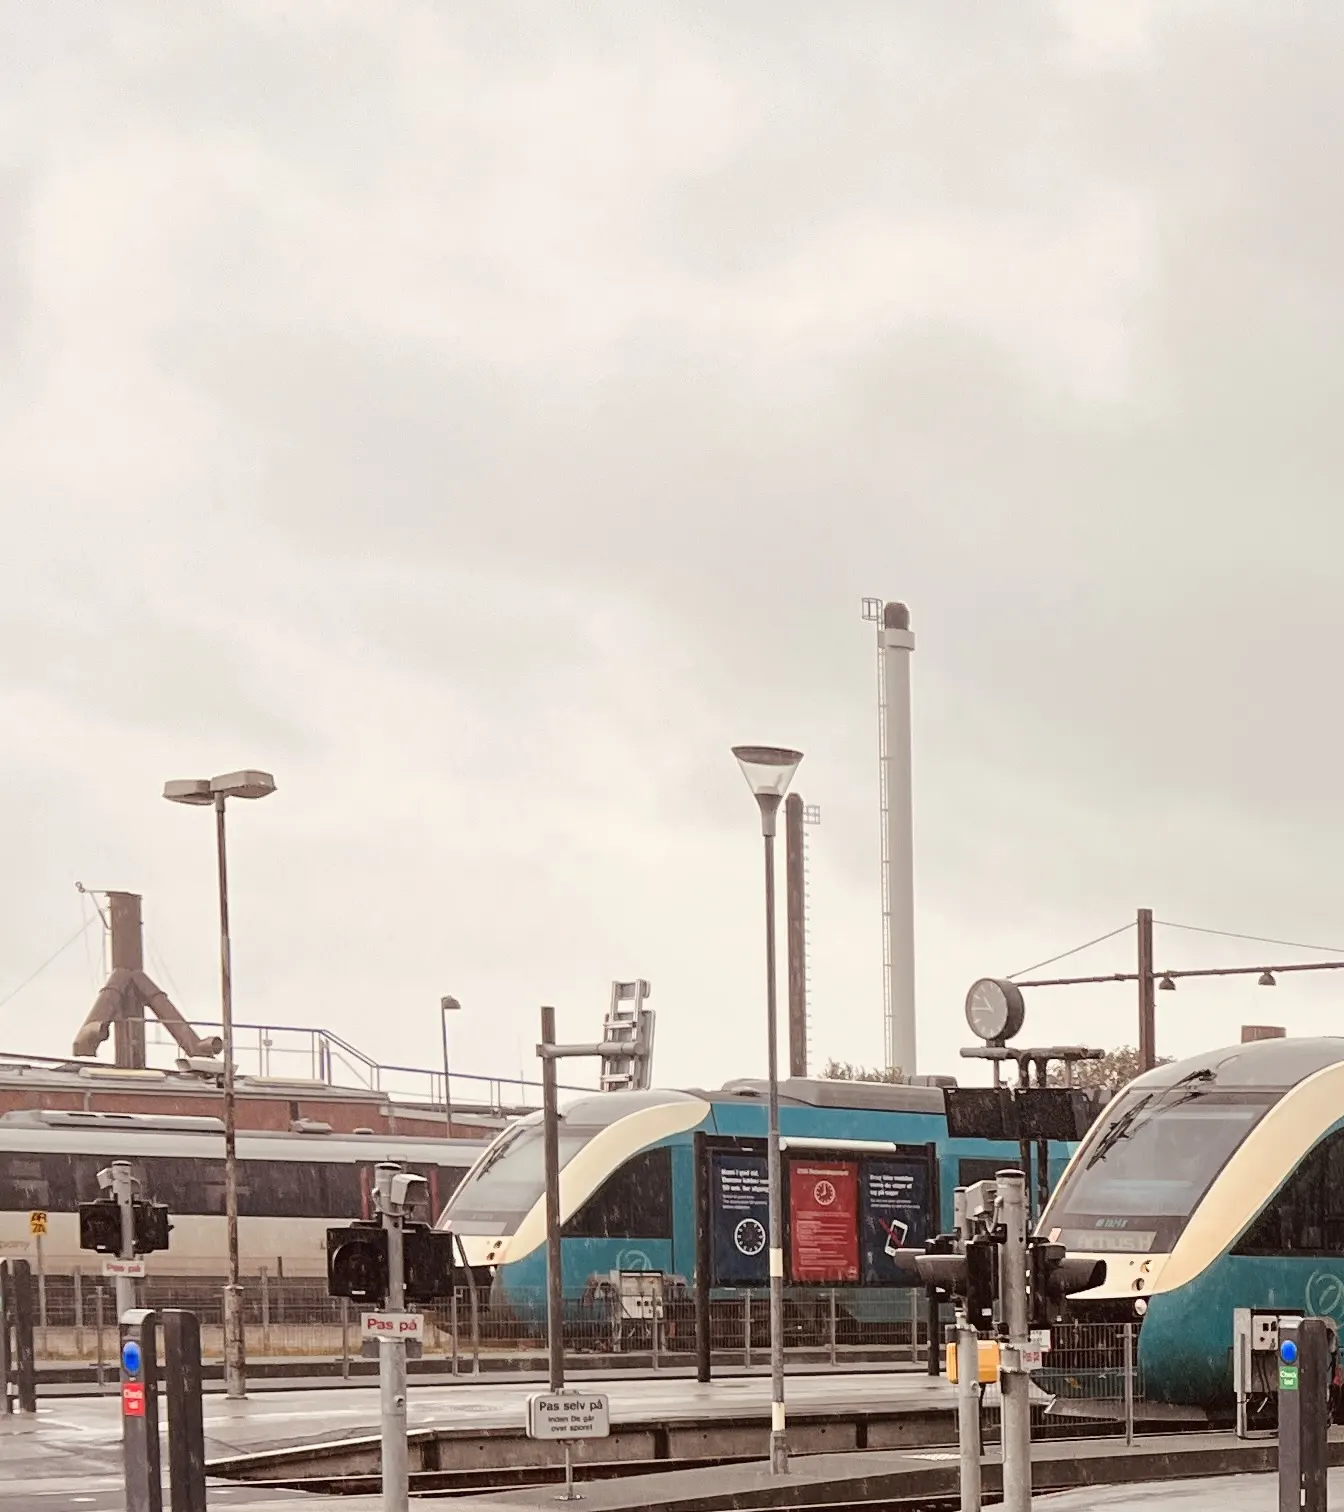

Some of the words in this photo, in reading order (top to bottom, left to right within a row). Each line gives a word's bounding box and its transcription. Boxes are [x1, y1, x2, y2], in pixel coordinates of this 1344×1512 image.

[367, 1318, 394, 1330] Pas
[399, 1318, 417, 1333] på
[540, 1401, 560, 1412] Pas
[563, 1400, 586, 1411] selv
[590, 1399, 603, 1412] på
